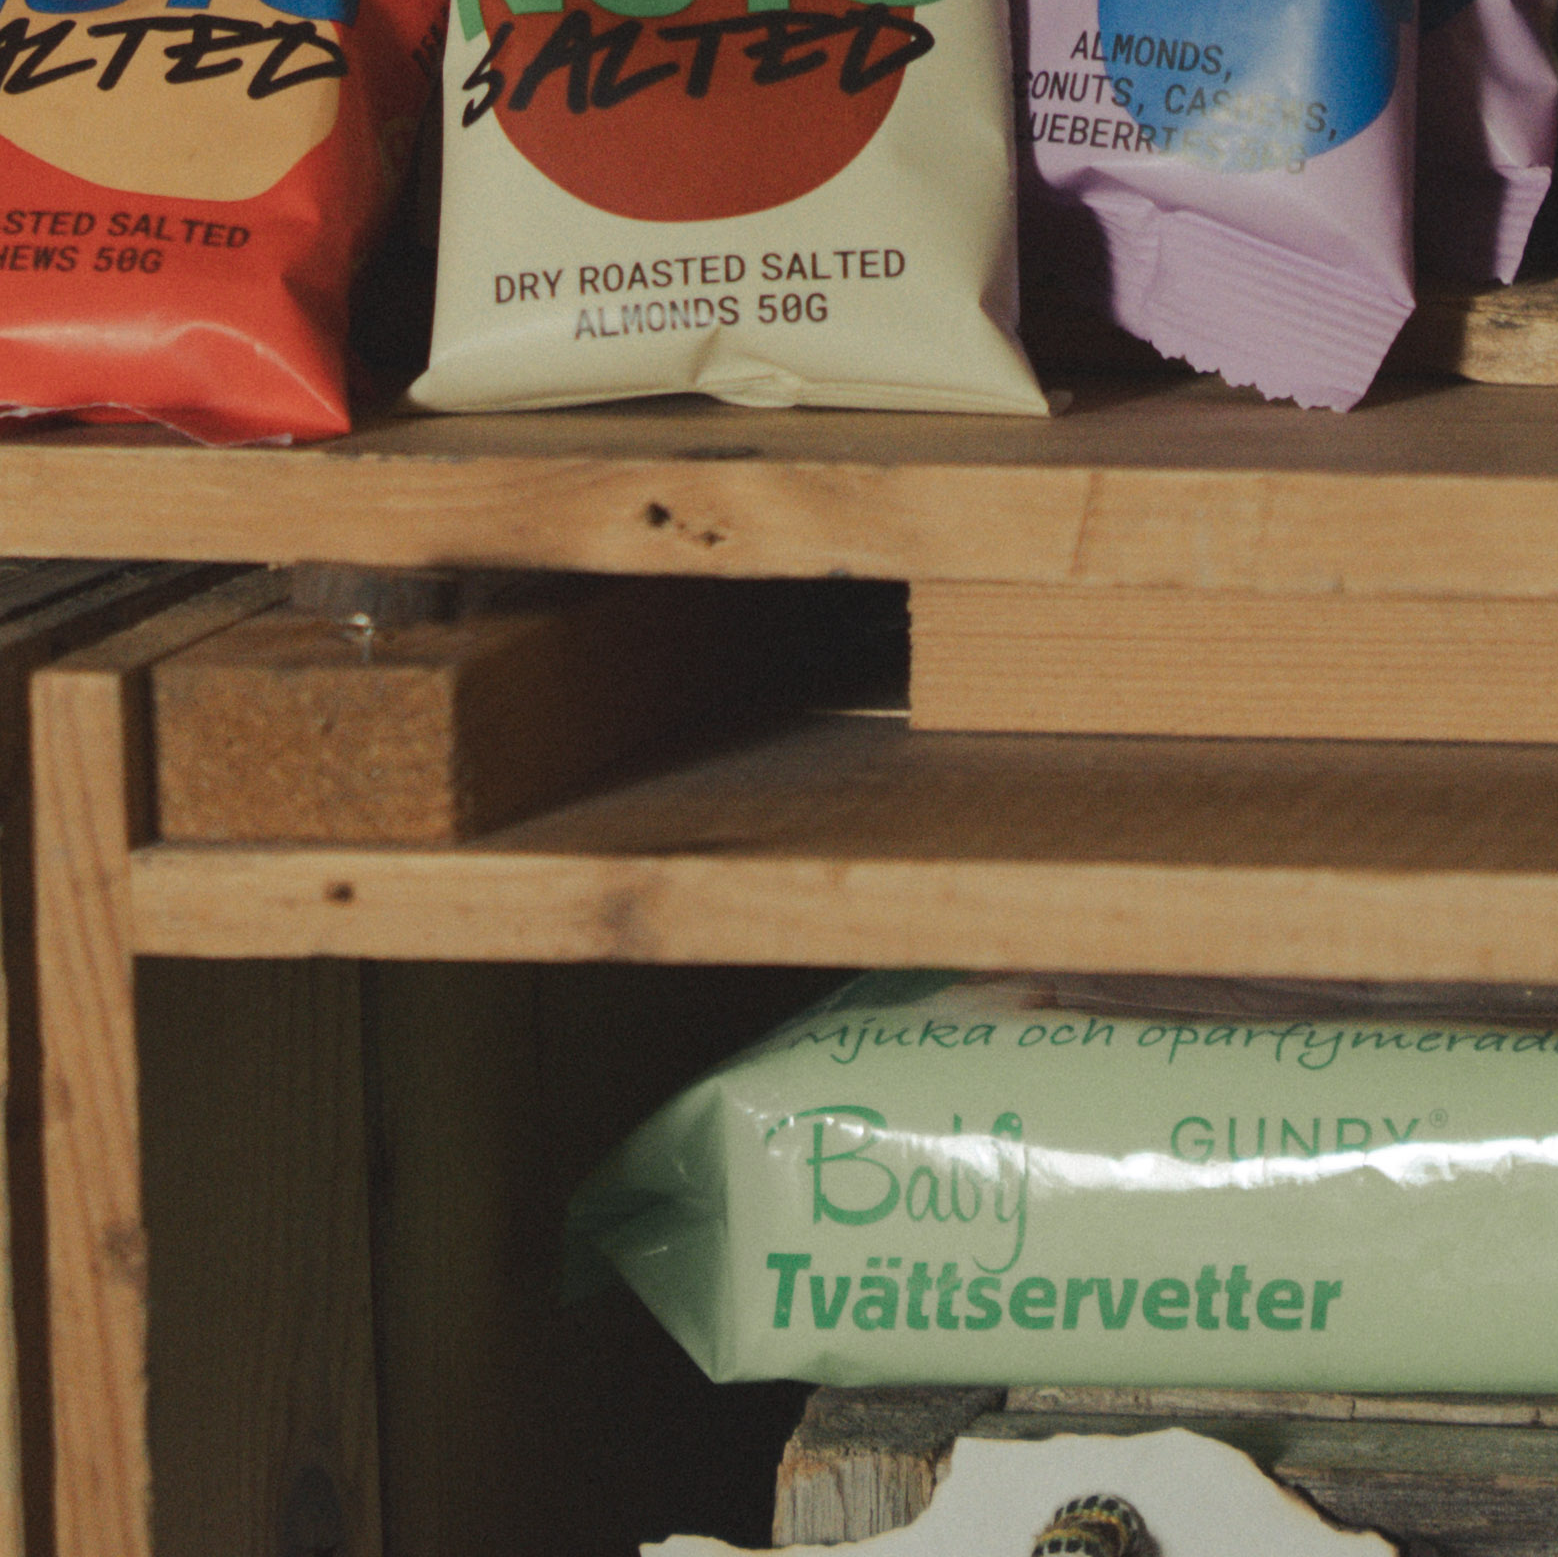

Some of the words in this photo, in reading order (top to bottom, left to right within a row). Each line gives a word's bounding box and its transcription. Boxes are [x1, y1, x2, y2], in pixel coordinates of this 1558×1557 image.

[462, 2, 936, 129] SALTED
[1069, 29, 1234, 83] ALMONDS,
[1028, 112, 1227, 166] UEBERRIES
[2, 210, 96, 238] STED
[107, 211, 252, 251] SALTED
[92, 247, 165, 276] 50G
[492, 265, 566, 304] DRY
[578, 255, 747, 297] ROASTED
[759, 248, 907, 284] SALTED
[573, 294, 741, 340] ALMONDS
[756, 290, 830, 326] 50G
[800, 1015, 997, 1065] mjuka
[1016, 1014, 1113, 1049] och
[765, 1104, 1031, 1274] Baby
[765, 1251, 1343, 1332] Tvättservetter
